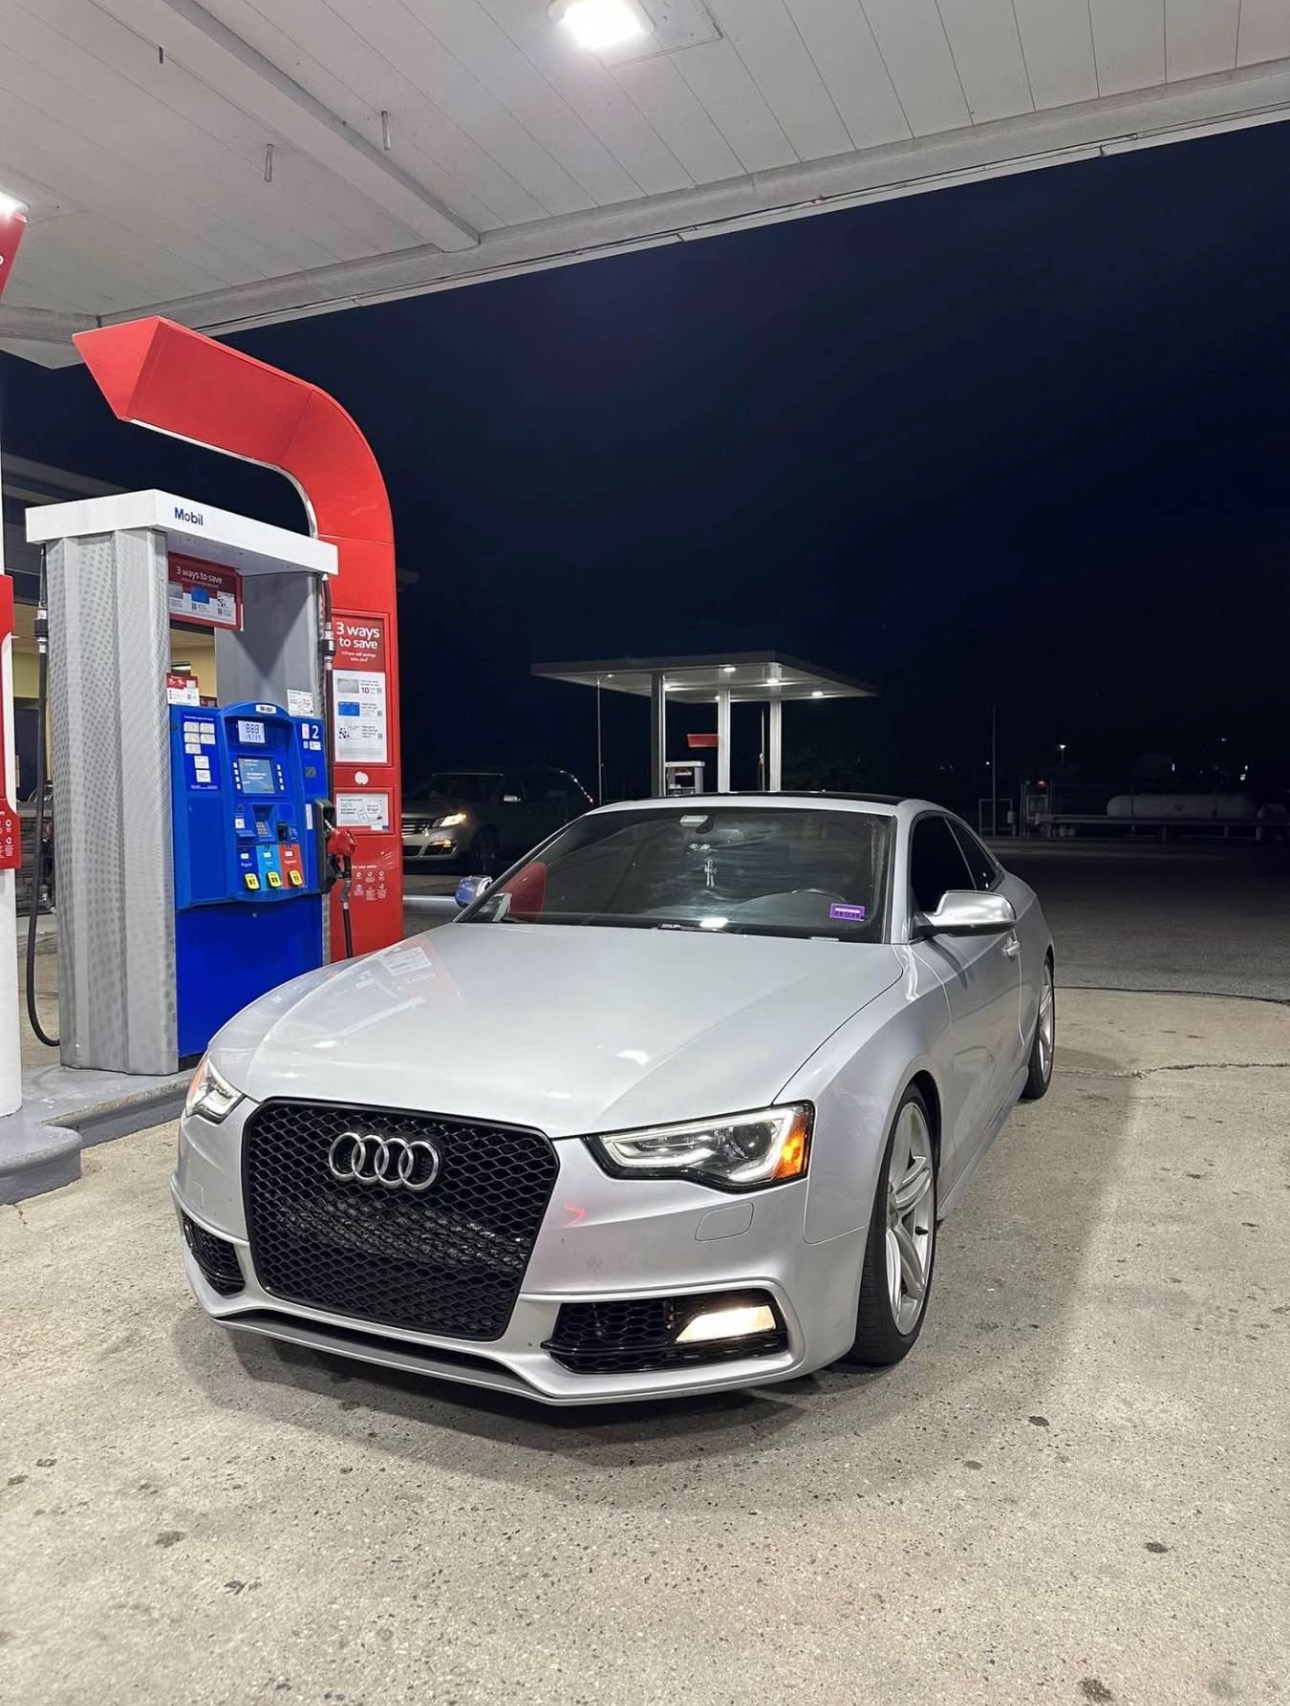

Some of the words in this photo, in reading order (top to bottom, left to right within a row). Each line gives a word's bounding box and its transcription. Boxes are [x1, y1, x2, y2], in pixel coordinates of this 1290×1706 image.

[174, 506, 204, 526] Mobil
[176, 565, 182, 575] 3
[182, 569, 200, 580] ways
[200, 572, 208, 581] to
[208, 575, 223, 584] save
[335, 621, 345, 635] 3
[346, 626, 380, 641] ways
[338, 636, 351, 648] to
[353, 639, 378, 650] save
[361, 686, 370, 695] 10
[312, 724, 320, 739] 2
